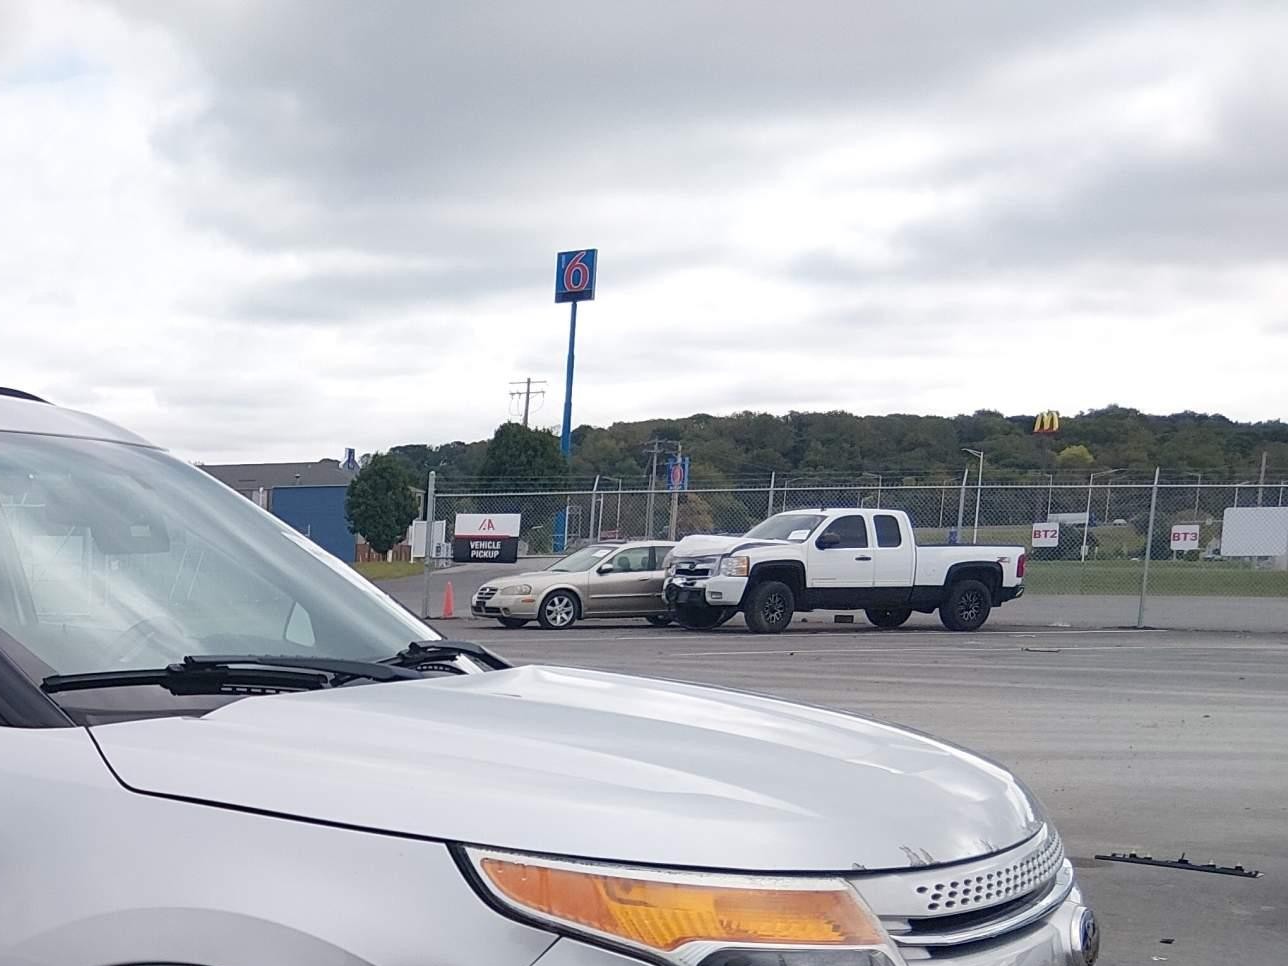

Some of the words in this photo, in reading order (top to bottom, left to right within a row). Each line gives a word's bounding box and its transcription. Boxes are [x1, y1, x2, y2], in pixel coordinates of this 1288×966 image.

[564, 251, 590, 292] 6
[1033, 529, 1058, 539] BT2
[1172, 532, 1198, 541] BT3
[469, 540, 502, 549] VEHICLE
[470, 550, 500, 559] PICKUP
